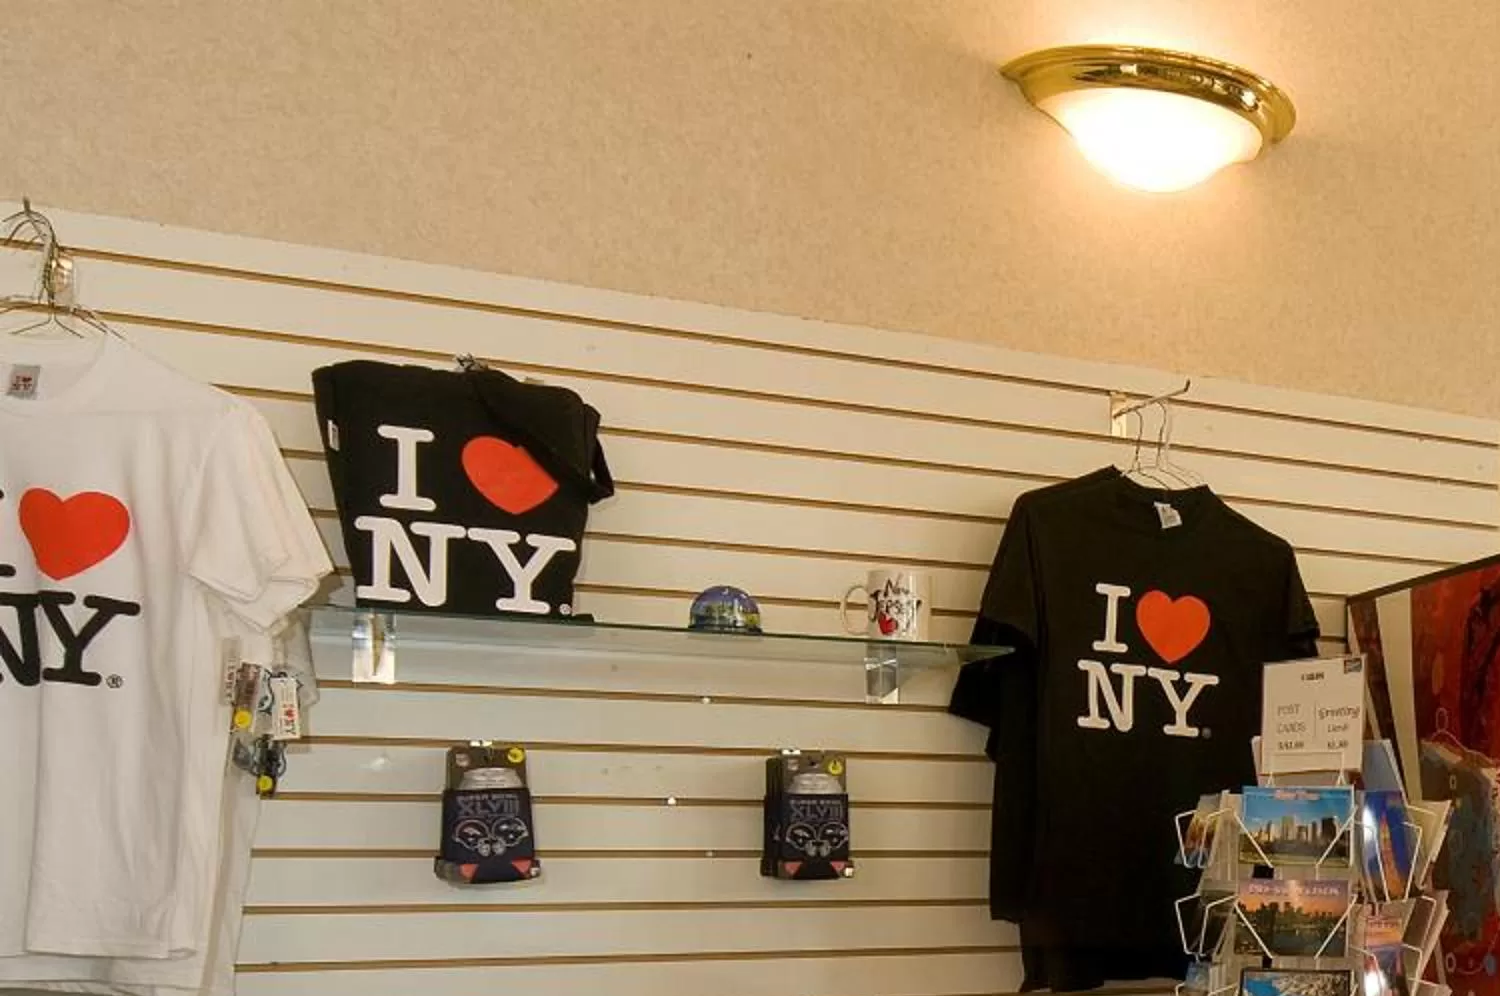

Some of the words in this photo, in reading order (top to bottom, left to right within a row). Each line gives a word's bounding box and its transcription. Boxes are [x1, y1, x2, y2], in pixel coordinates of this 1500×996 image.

[377, 424, 435, 511] I
[354, 515, 576, 615] NY
[1093, 582, 1132, 653] I
[1076, 658, 1220, 738] NY
